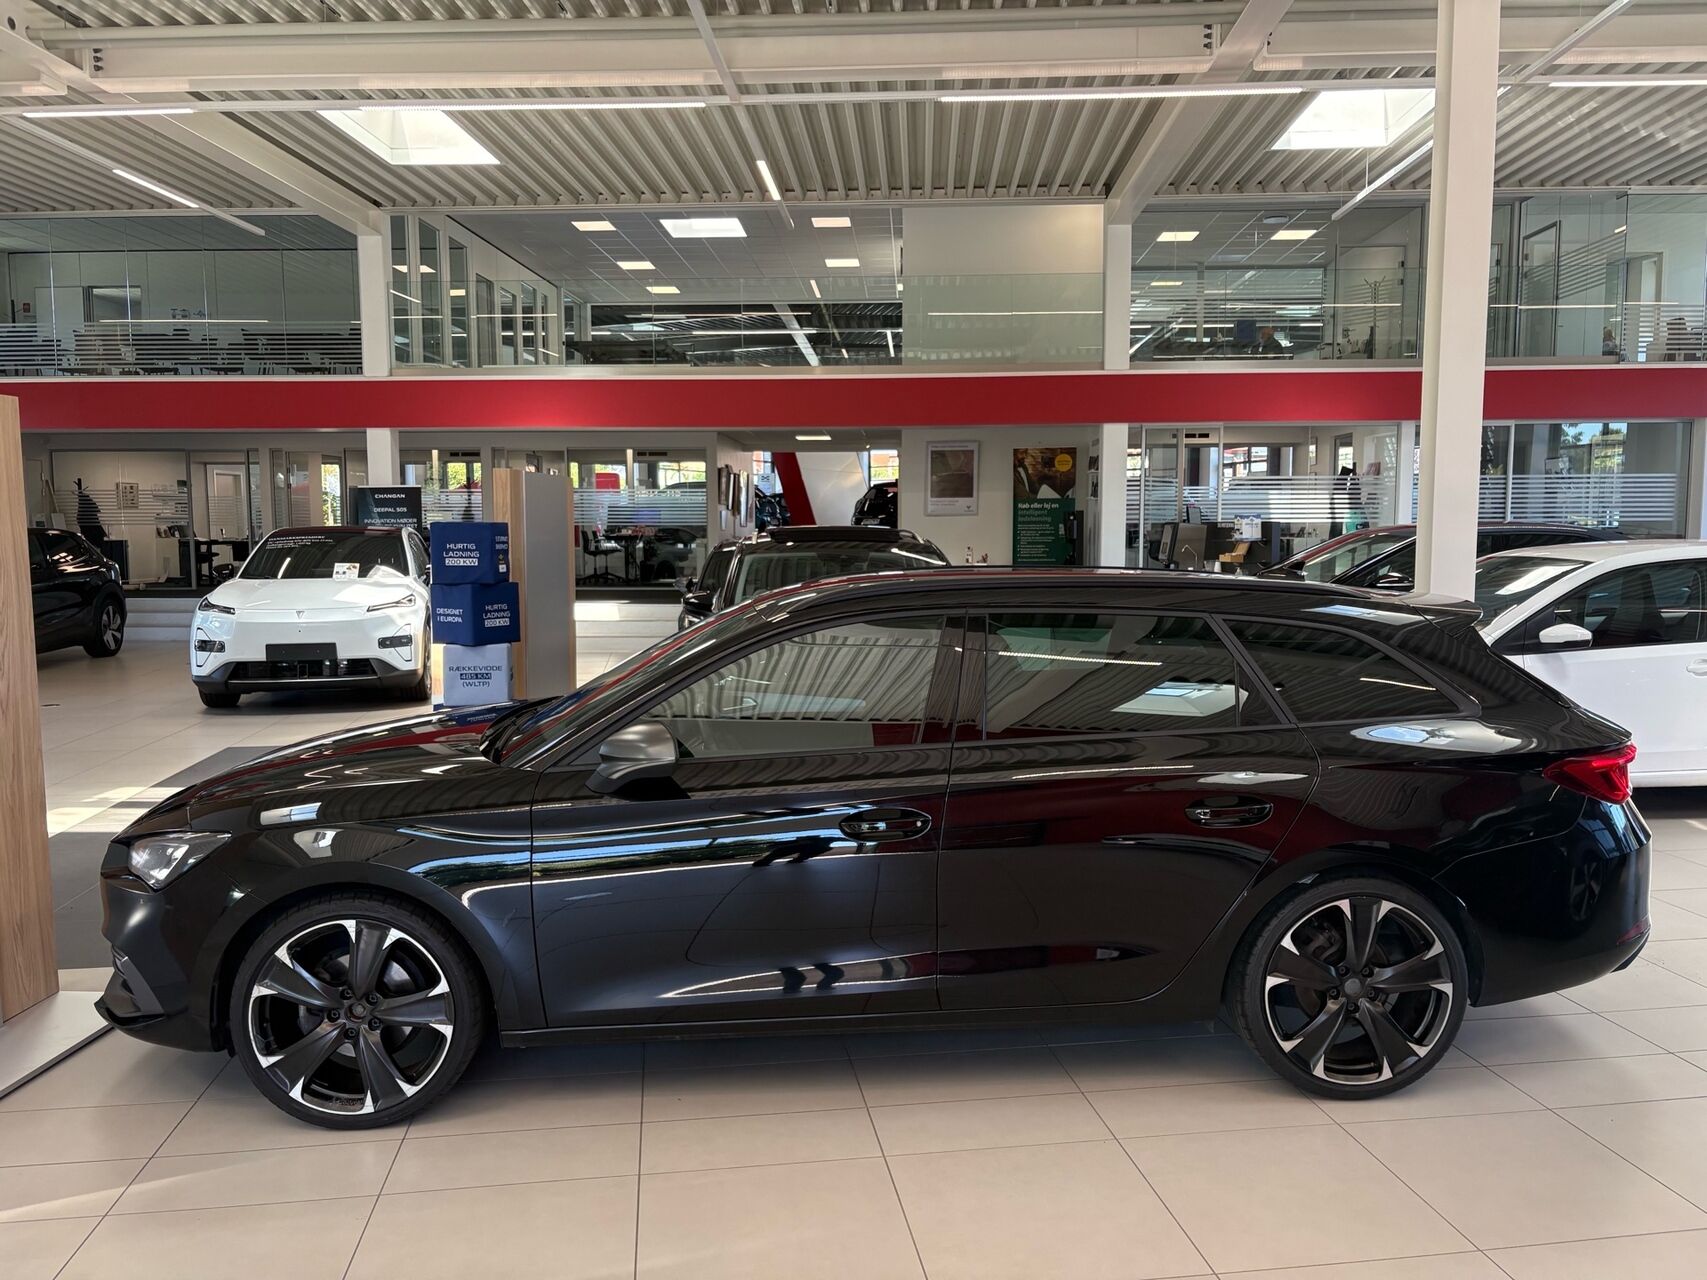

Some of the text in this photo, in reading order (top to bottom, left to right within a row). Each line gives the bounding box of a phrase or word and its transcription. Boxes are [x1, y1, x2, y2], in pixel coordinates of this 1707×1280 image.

[485, 603, 508, 611] HURTIG
[436, 607, 463, 616] DESIGNET
[482, 611, 511, 619] LADNING
[462, 680, 491, 688] (WLTP)
